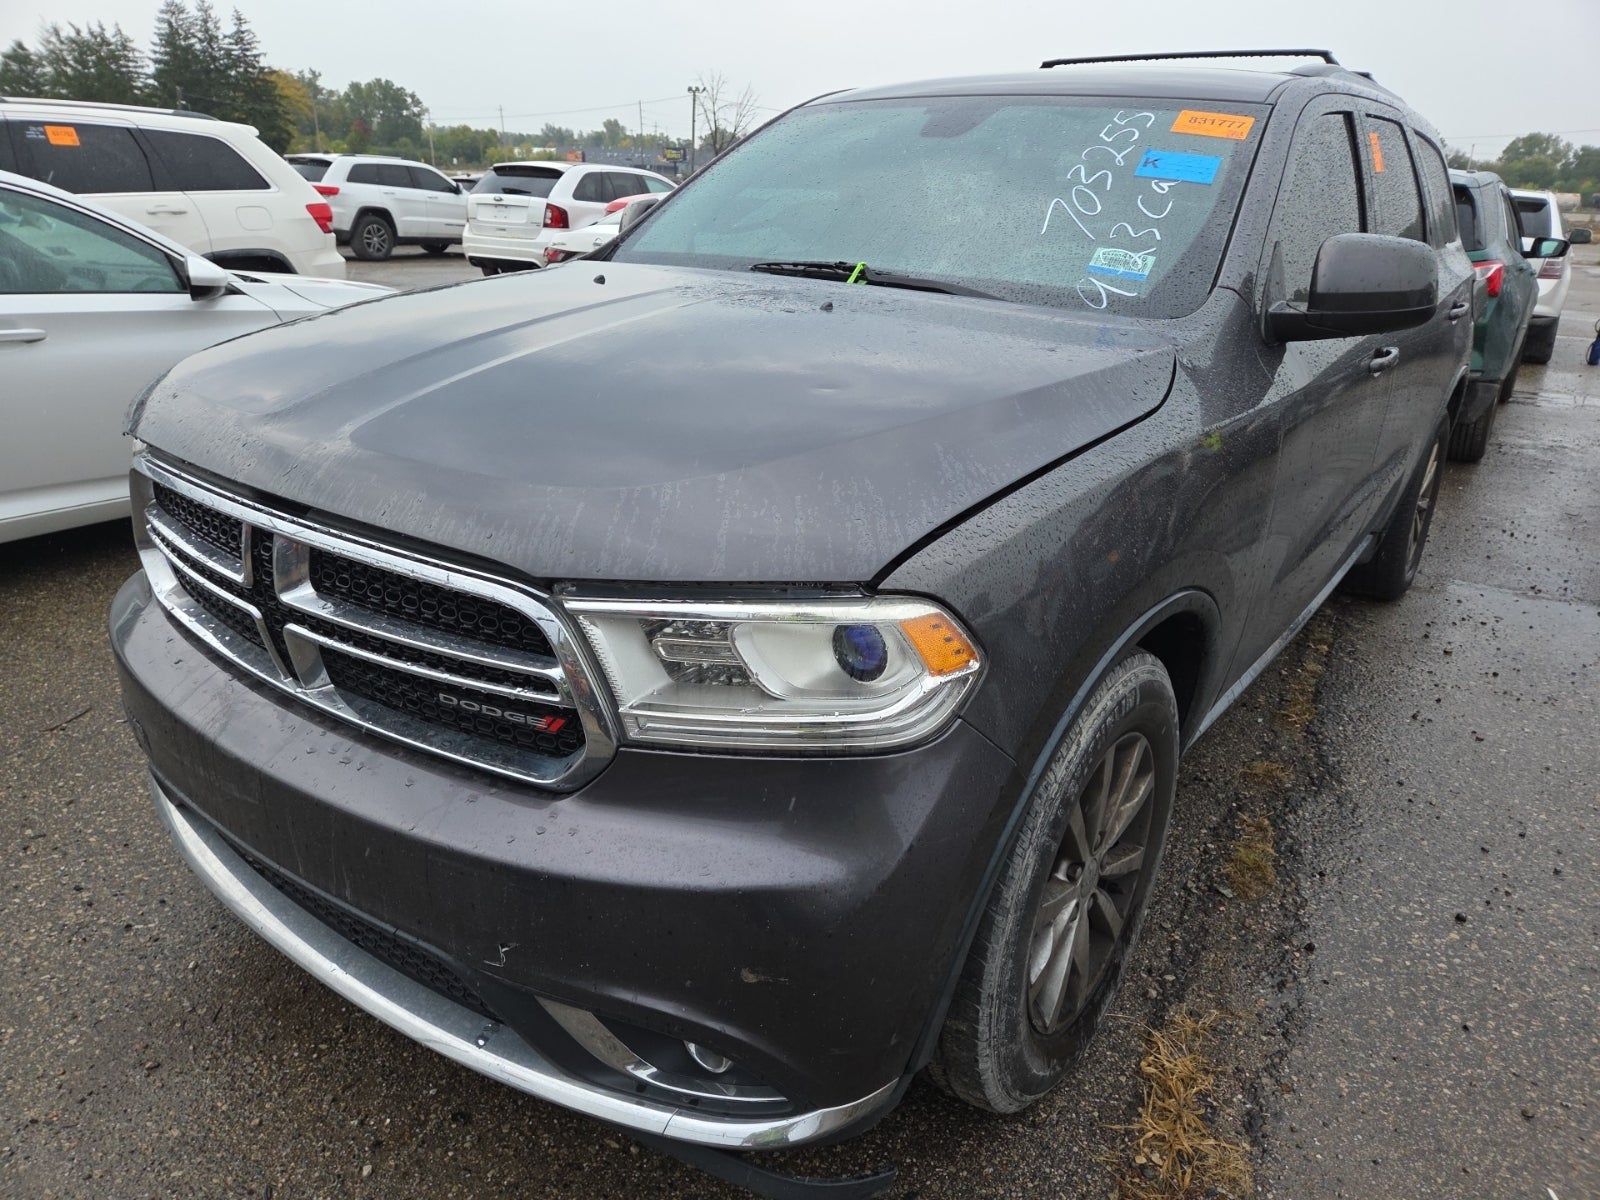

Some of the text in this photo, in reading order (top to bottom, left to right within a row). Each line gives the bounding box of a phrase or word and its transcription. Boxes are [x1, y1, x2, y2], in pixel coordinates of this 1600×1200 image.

[1187, 116, 1247, 129] 831777
[1142, 156, 1162, 169] K
[1040, 110, 1156, 240] 703255
[438, 693, 548, 729] DODGE
